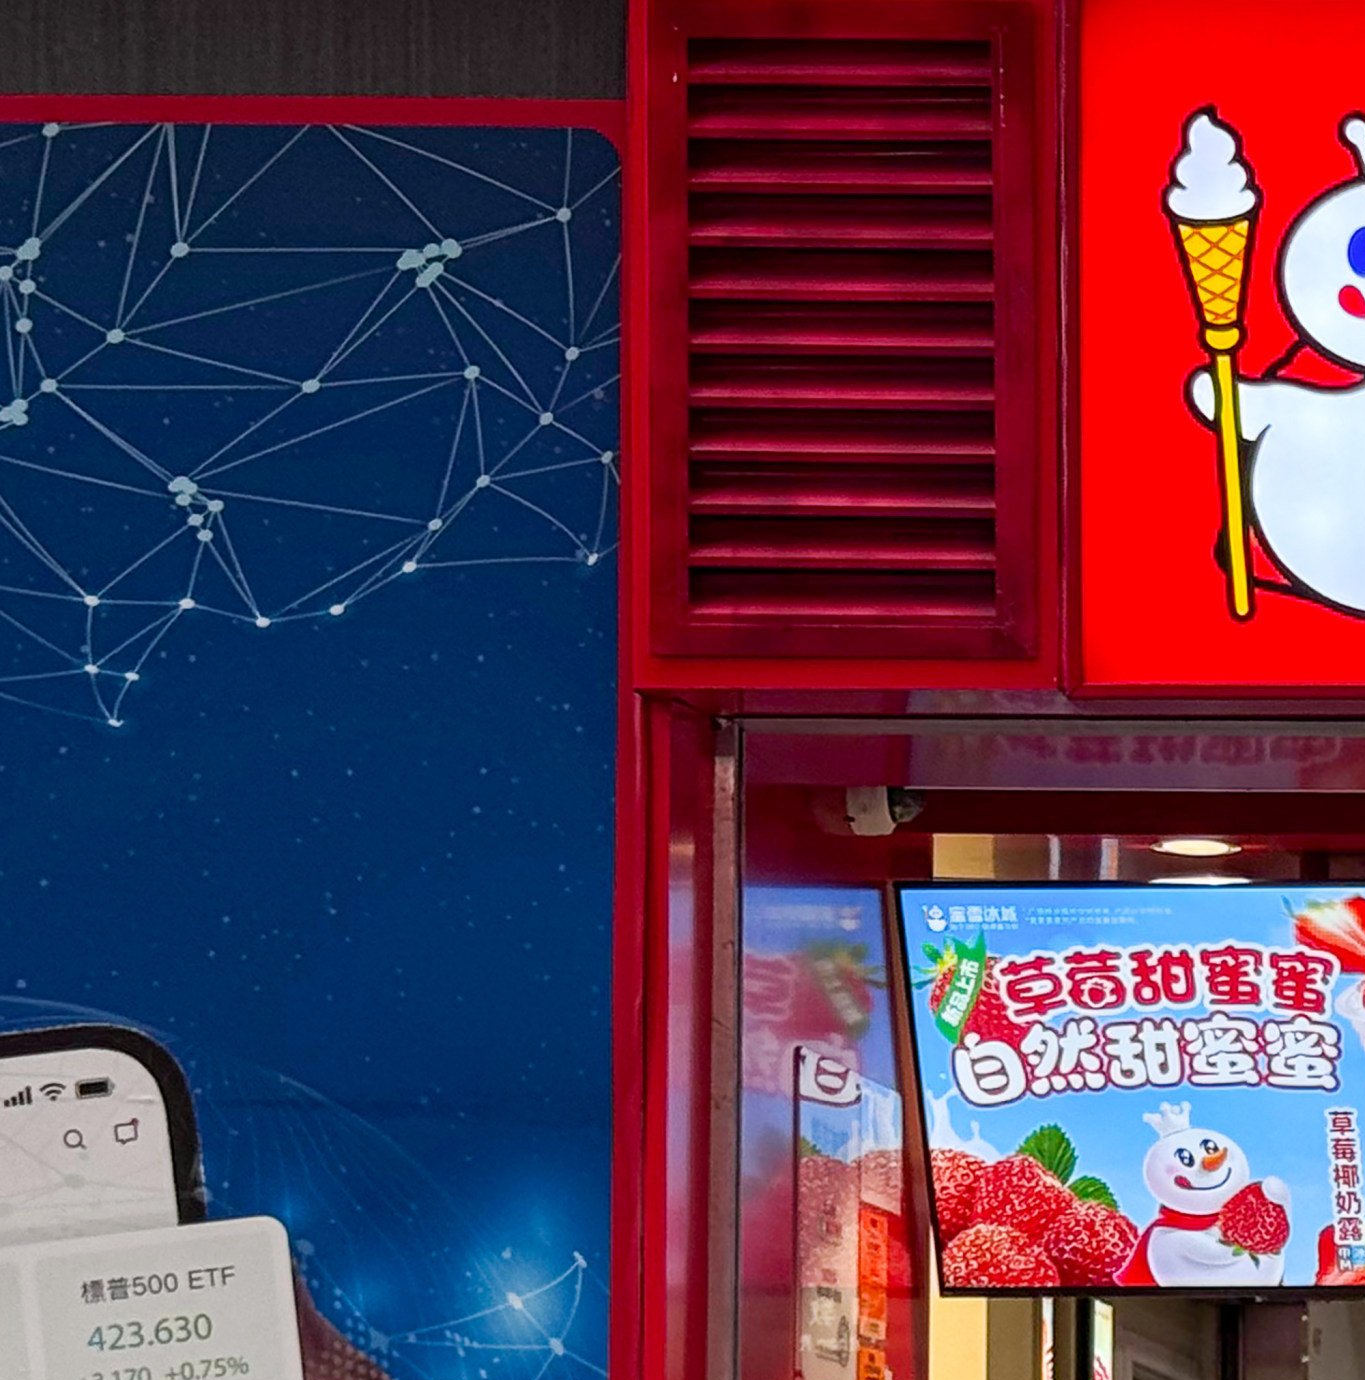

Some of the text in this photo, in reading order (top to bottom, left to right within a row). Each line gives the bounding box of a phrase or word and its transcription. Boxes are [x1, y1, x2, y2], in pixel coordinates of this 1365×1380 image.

[949, 906, 1018, 923] 蜜雪冰城
[941, 958, 981, 1028] 新品上市
[1001, 945, 1334, 1017] 草莓甜蜜蜜
[956, 1013, 1341, 1104] 自然甜蜜蜜
[1329, 1111, 1363, 1242] 草莓椰奶露
[80, 1265, 236, 1304] 標普500 ETF
[87, 1313, 213, 1351] 423.630
